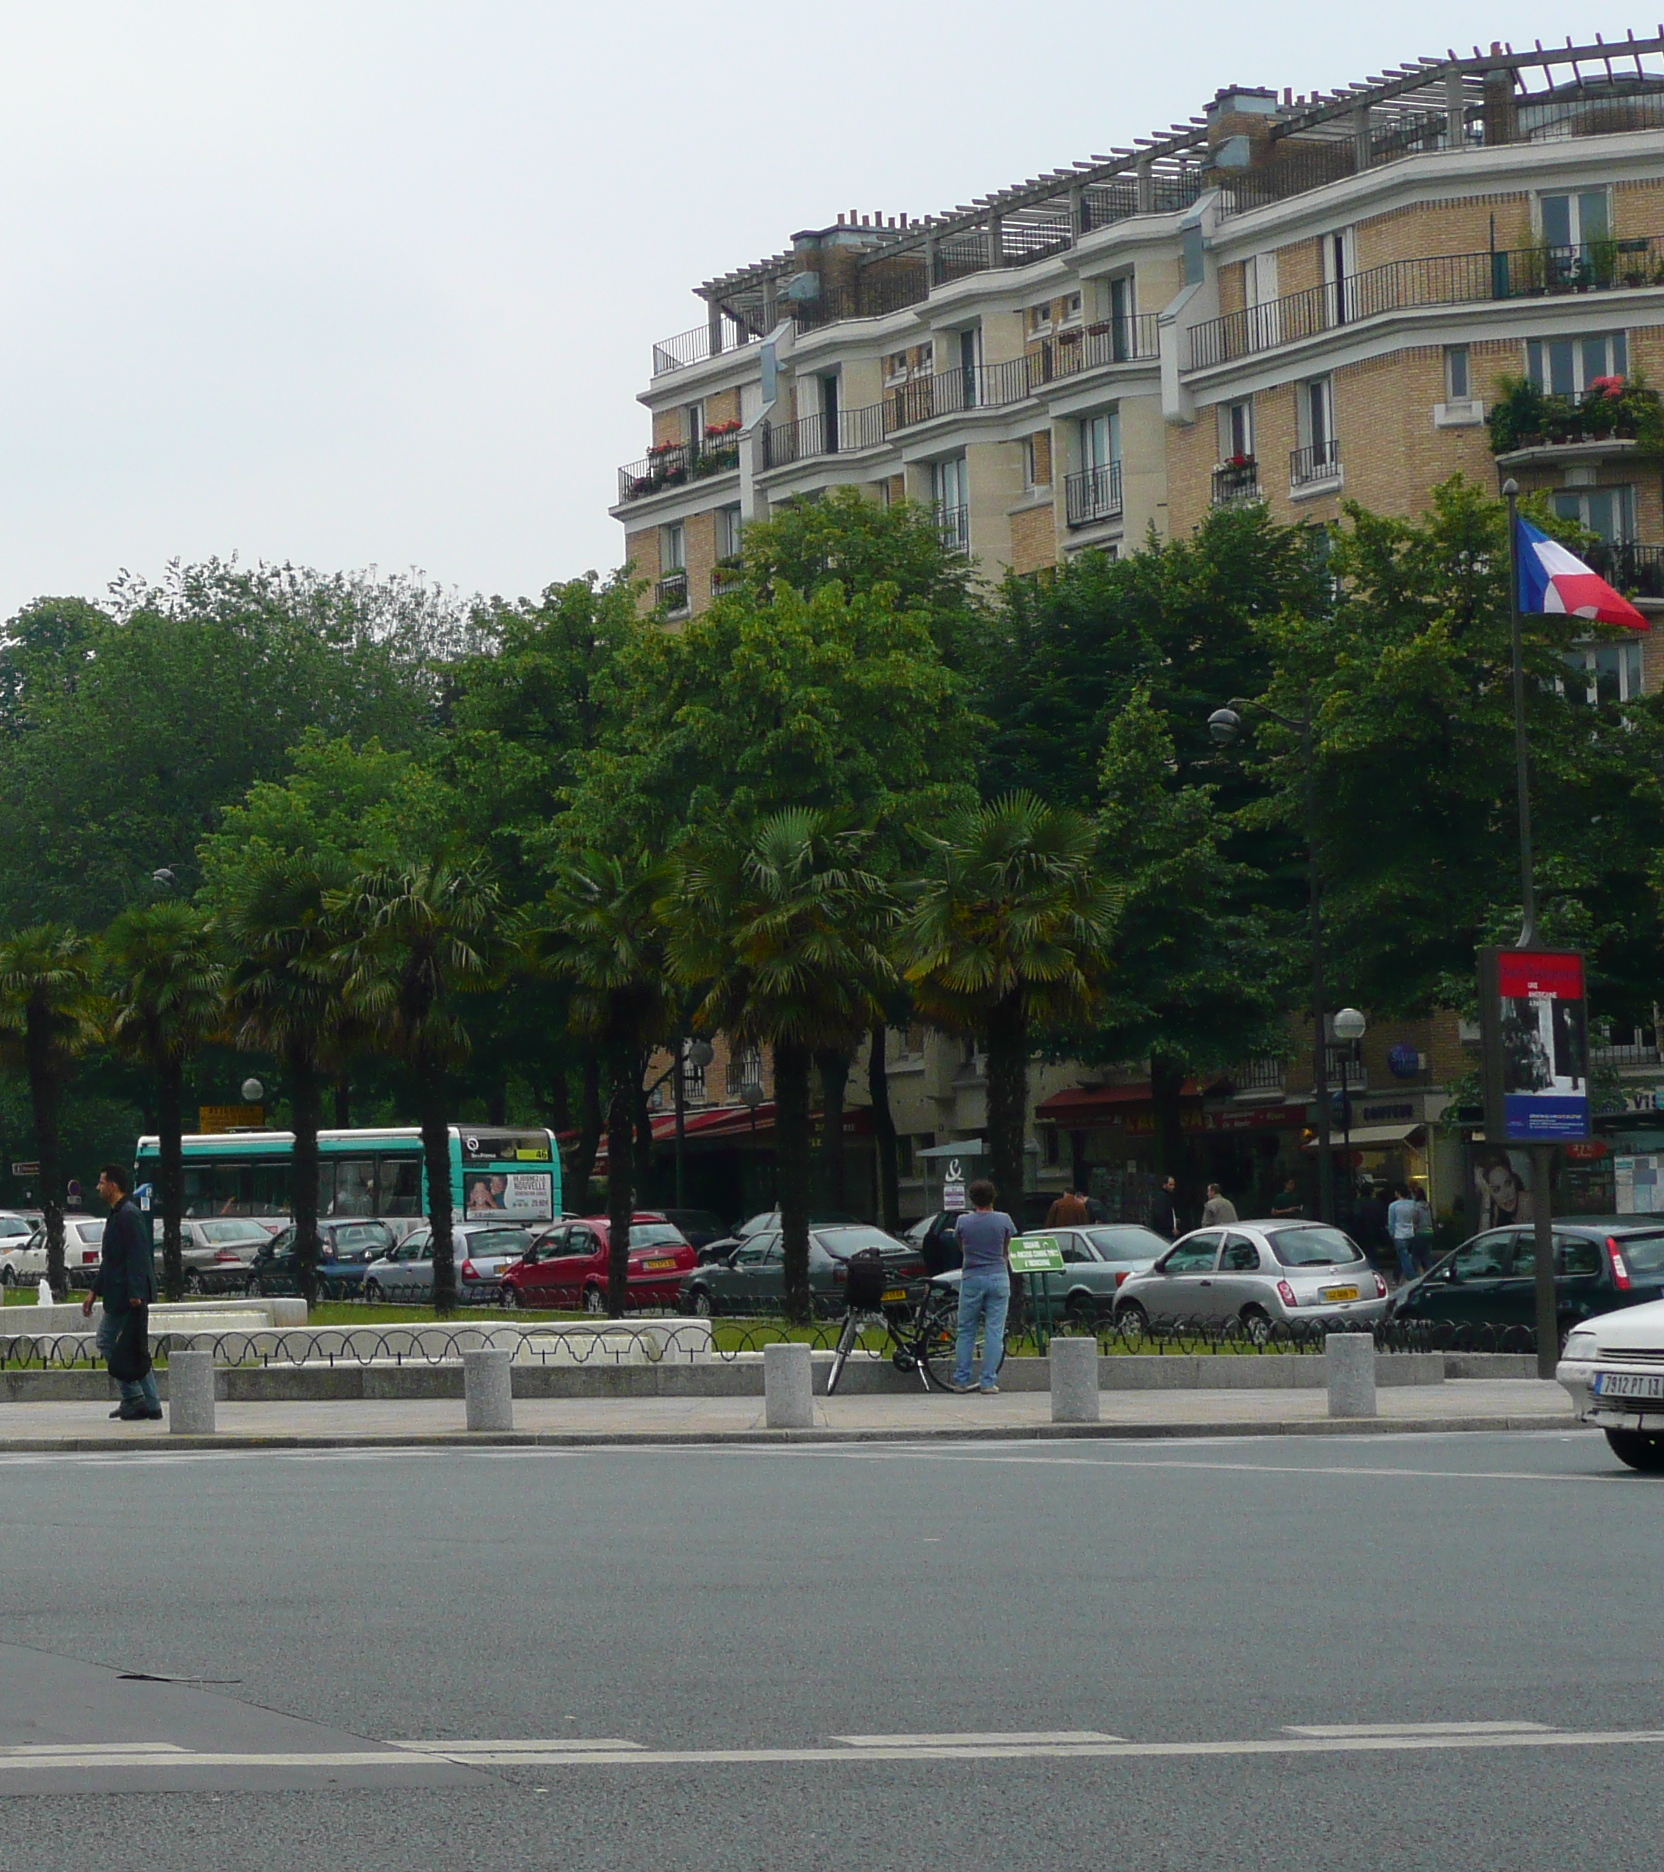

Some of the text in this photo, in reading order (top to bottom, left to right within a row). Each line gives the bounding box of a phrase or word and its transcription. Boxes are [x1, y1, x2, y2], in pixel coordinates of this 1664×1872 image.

[536, 1150, 547, 1158] 46
[514, 1181, 546, 1190] NOUVELLE
[1630, 1377, 1644, 1394] PT
